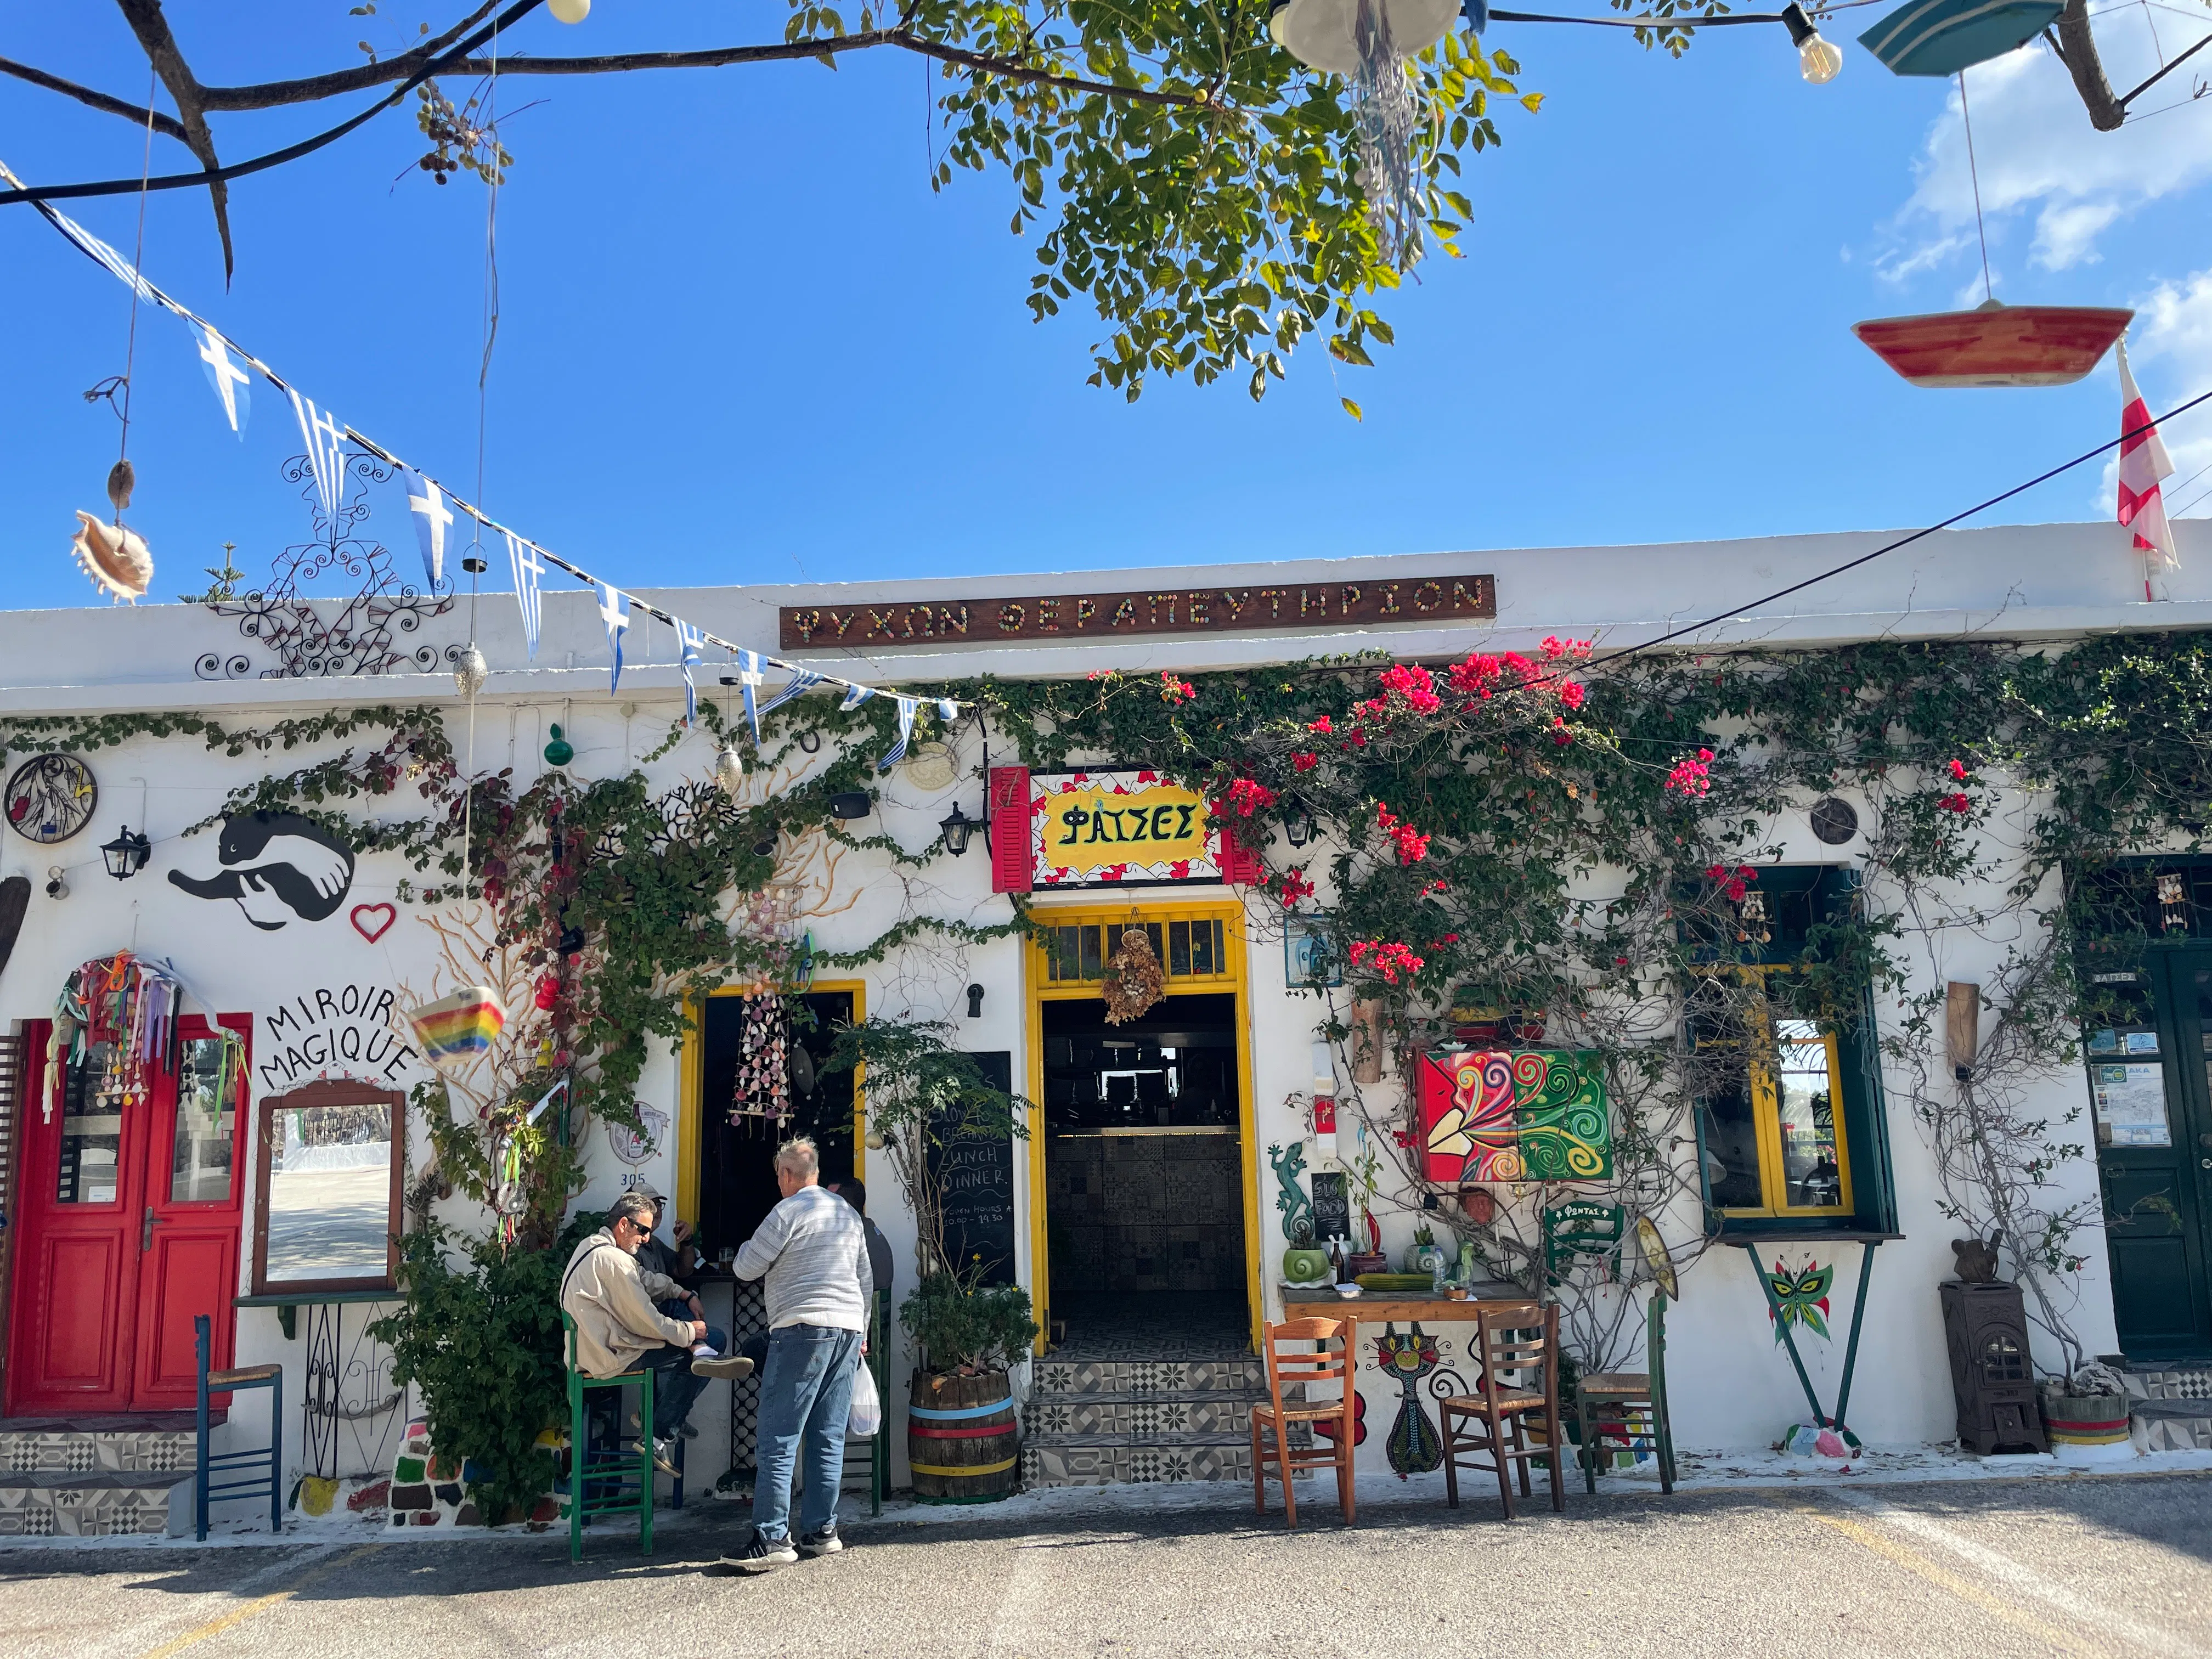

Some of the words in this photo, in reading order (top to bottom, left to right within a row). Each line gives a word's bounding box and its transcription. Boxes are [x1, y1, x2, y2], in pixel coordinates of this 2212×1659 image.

[793, 605, 968, 644] ΨΥΧΩΝ
[997, 579, 1482, 631] ΘΕΡΑΠΕΥΤΗΡΙΟΝ
[1058, 805, 1197, 844] ΦΑΤΣΕΣ
[267, 984, 394, 1042] MIROIR
[259, 1026, 419, 1090] MAGIQUE
[941, 1146, 997, 1166] LUNCH
[621, 1173, 645, 1186] 305
[949, 1207, 970, 1215] OPEN
[973, 1204, 1002, 1214] HOURS
